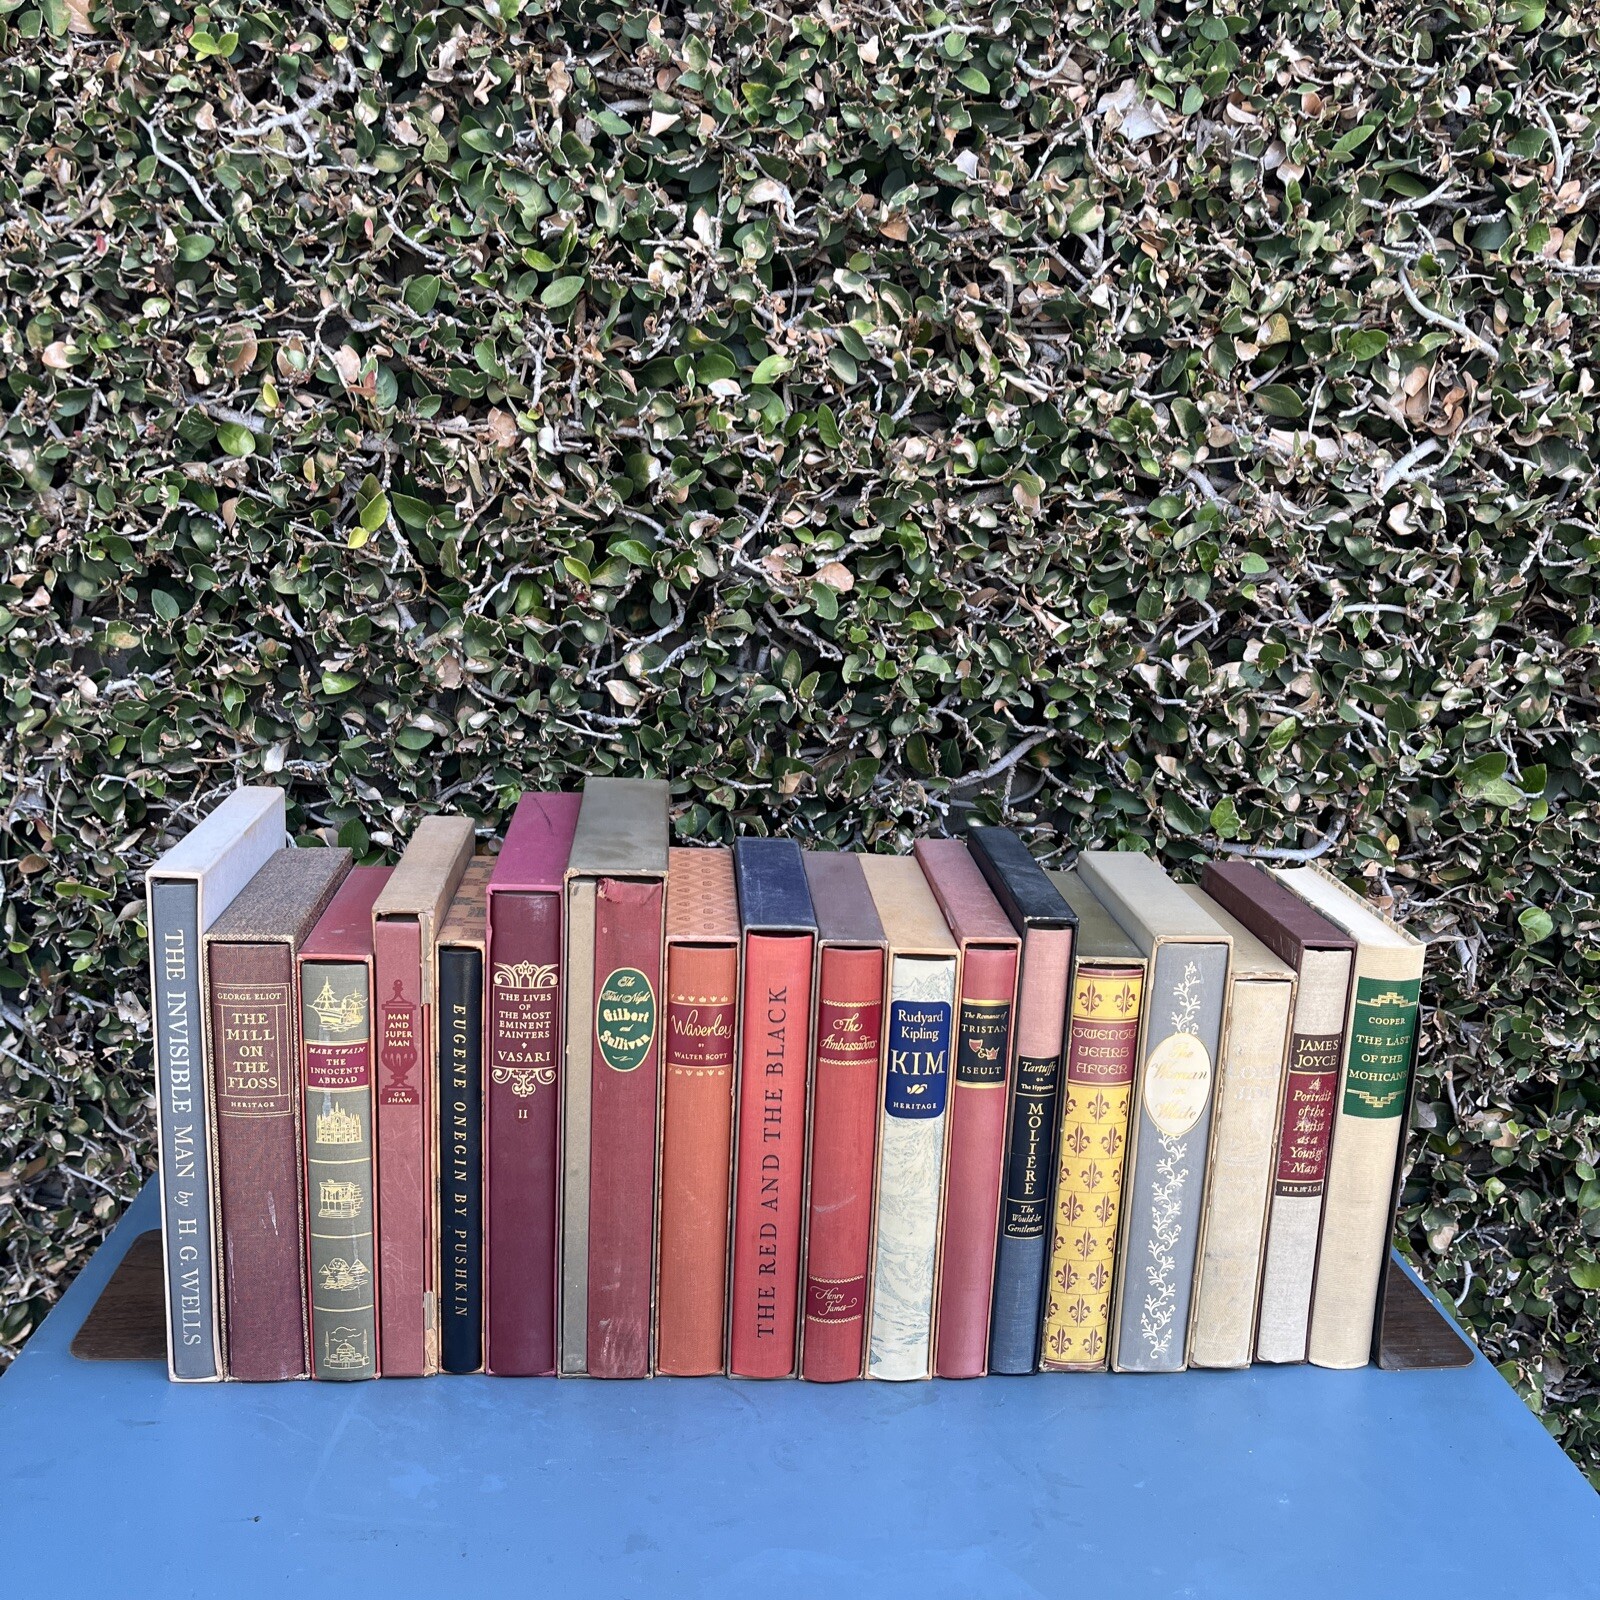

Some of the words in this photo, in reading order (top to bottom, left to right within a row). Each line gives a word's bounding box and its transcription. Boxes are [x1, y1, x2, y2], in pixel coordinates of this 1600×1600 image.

[165, 929, 186, 980] THE
[217, 993, 251, 1001] GEORGE
[254, 992, 282, 1000] ELIOT
[499, 992, 520, 1001] THE
[523, 993, 552, 1002] LIVES
[232, 1013, 269, 1025] THE
[499, 1010, 519, 1020] THE
[522, 1011, 552, 1020] MOST
[603, 1007, 650, 1023] Gilbert
[898, 1009, 943, 1026] Rudyard
[964, 1011, 975, 1019] The
[1368, 1016, 1406, 1026] COOPER
[389, 1021, 409, 1029] AND
[499, 1020, 551, 1030] EMINENT
[671, 1009, 733, 1039] Waverley
[832, 1012, 863, 1032] The
[225, 1028, 275, 1041] MILL
[385, 1030, 413, 1038] SUPER
[499, 1029, 550, 1039] PAINTERS
[765, 985, 788, 1078] BLACK
[901, 1026, 939, 1043] Kipling
[961, 1024, 1008, 1034] TRISTAN
[1073, 1026, 1137, 1040] TWENTY
[388, 1039, 410, 1047] MAN
[453, 1004, 467, 1089] EUGENE
[600, 1029, 651, 1051] Sullivan
[820, 1033, 878, 1051] Ambassadors
[1297, 1039, 1339, 1053] JAMES
[1356, 1034, 1383, 1046] THE
[1386, 1035, 1411, 1046] LAST
[167, 991, 192, 1114] INVISIBLE
[239, 1045, 264, 1057] ON
[309, 1047, 333, 1055] MARK
[334, 1046, 365, 1055] TWAIN
[497, 1050, 551, 1062] VASARI
[674, 1051, 703, 1060] WALTER
[705, 1052, 728, 1061] SCOTT
[1078, 1045, 1130, 1058] YEARS
[326, 1058, 347, 1066] THE
[890, 1049, 946, 1075] KIM
[1294, 1054, 1337, 1069] JOYCE
[1361, 1054, 1378, 1063] OF
[1380, 1054, 1403, 1064] THE
[232, 1061, 270, 1073] THE
[310, 1065, 365, 1075] INNOCENTS
[961, 1065, 1002, 1075] ISEULT
[1076, 1062, 1128, 1075] AFTER
[318, 1076, 358, 1084] ABROAD
[1348, 1068, 1408, 1082] MOHICANS
[227, 1076, 278, 1089] FLOSS
[1309, 1077, 1321, 1091] A
[1293, 1090, 1332, 1102] Portrait
[893, 1101, 937, 1110] HERITAGE
[518, 1109, 528, 1119] II
[763, 1087, 783, 1143] THE
[1298, 1106, 1309, 1120] of
[1310, 1105, 1325, 1117] the
[453, 1101, 467, 1182] ONEGIN
[1297, 1136, 1308, 1144] as
[1310, 1136, 1318, 1144] a
[173, 1124, 195, 1179] MAN
[1290, 1147, 1323, 1162] Young
[1291, 1161, 1319, 1175] Man
[761, 1153, 780, 1212] AND
[1282, 1185, 1322, 1193] HERITAGE
[174, 1190, 194, 1207] by
[454, 1193, 467, 1216] BY
[1020, 1205, 1034, 1213] The
[1012, 1213, 1041, 1223] Would-be
[178, 1218, 197, 1240] H.
[1007, 1224, 1043, 1233] Gentleman
[758, 1222, 778, 1276] RED
[179, 1246, 198, 1266] G.
[454, 1229, 468, 1317] PUSHKIN
[810, 1286, 845, 1303] Henry
[180, 1267, 202, 1346] WELLS
[817, 1297, 858, 1315] James
[757, 1287, 775, 1339] THE
